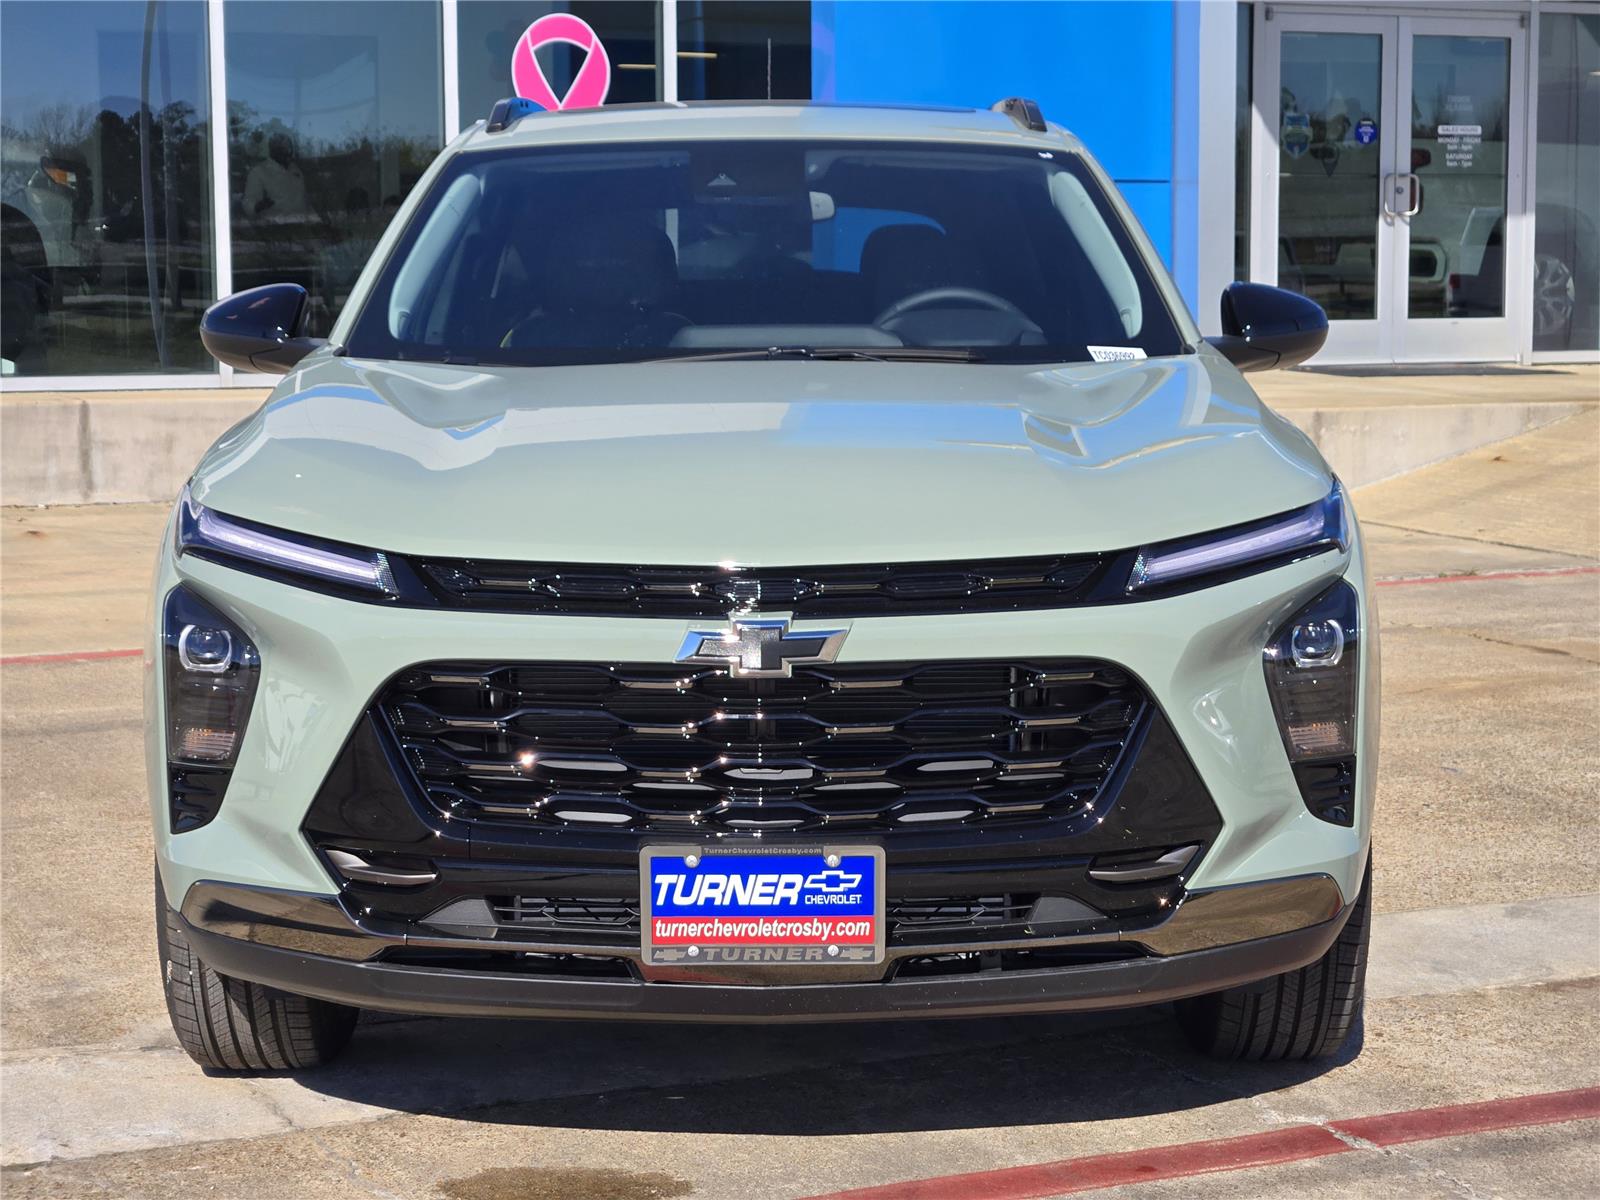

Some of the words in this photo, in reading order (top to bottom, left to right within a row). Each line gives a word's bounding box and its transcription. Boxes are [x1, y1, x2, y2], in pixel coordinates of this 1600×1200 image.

[704, 847, 822, 856] TurnerChevroletCrosby.com
[654, 874, 803, 906] TURNER
[804, 894, 862, 905] CHEVROLET
[655, 918, 871, 941] turnerchevroletcrosby.com
[704, 948, 824, 961] TURNER
